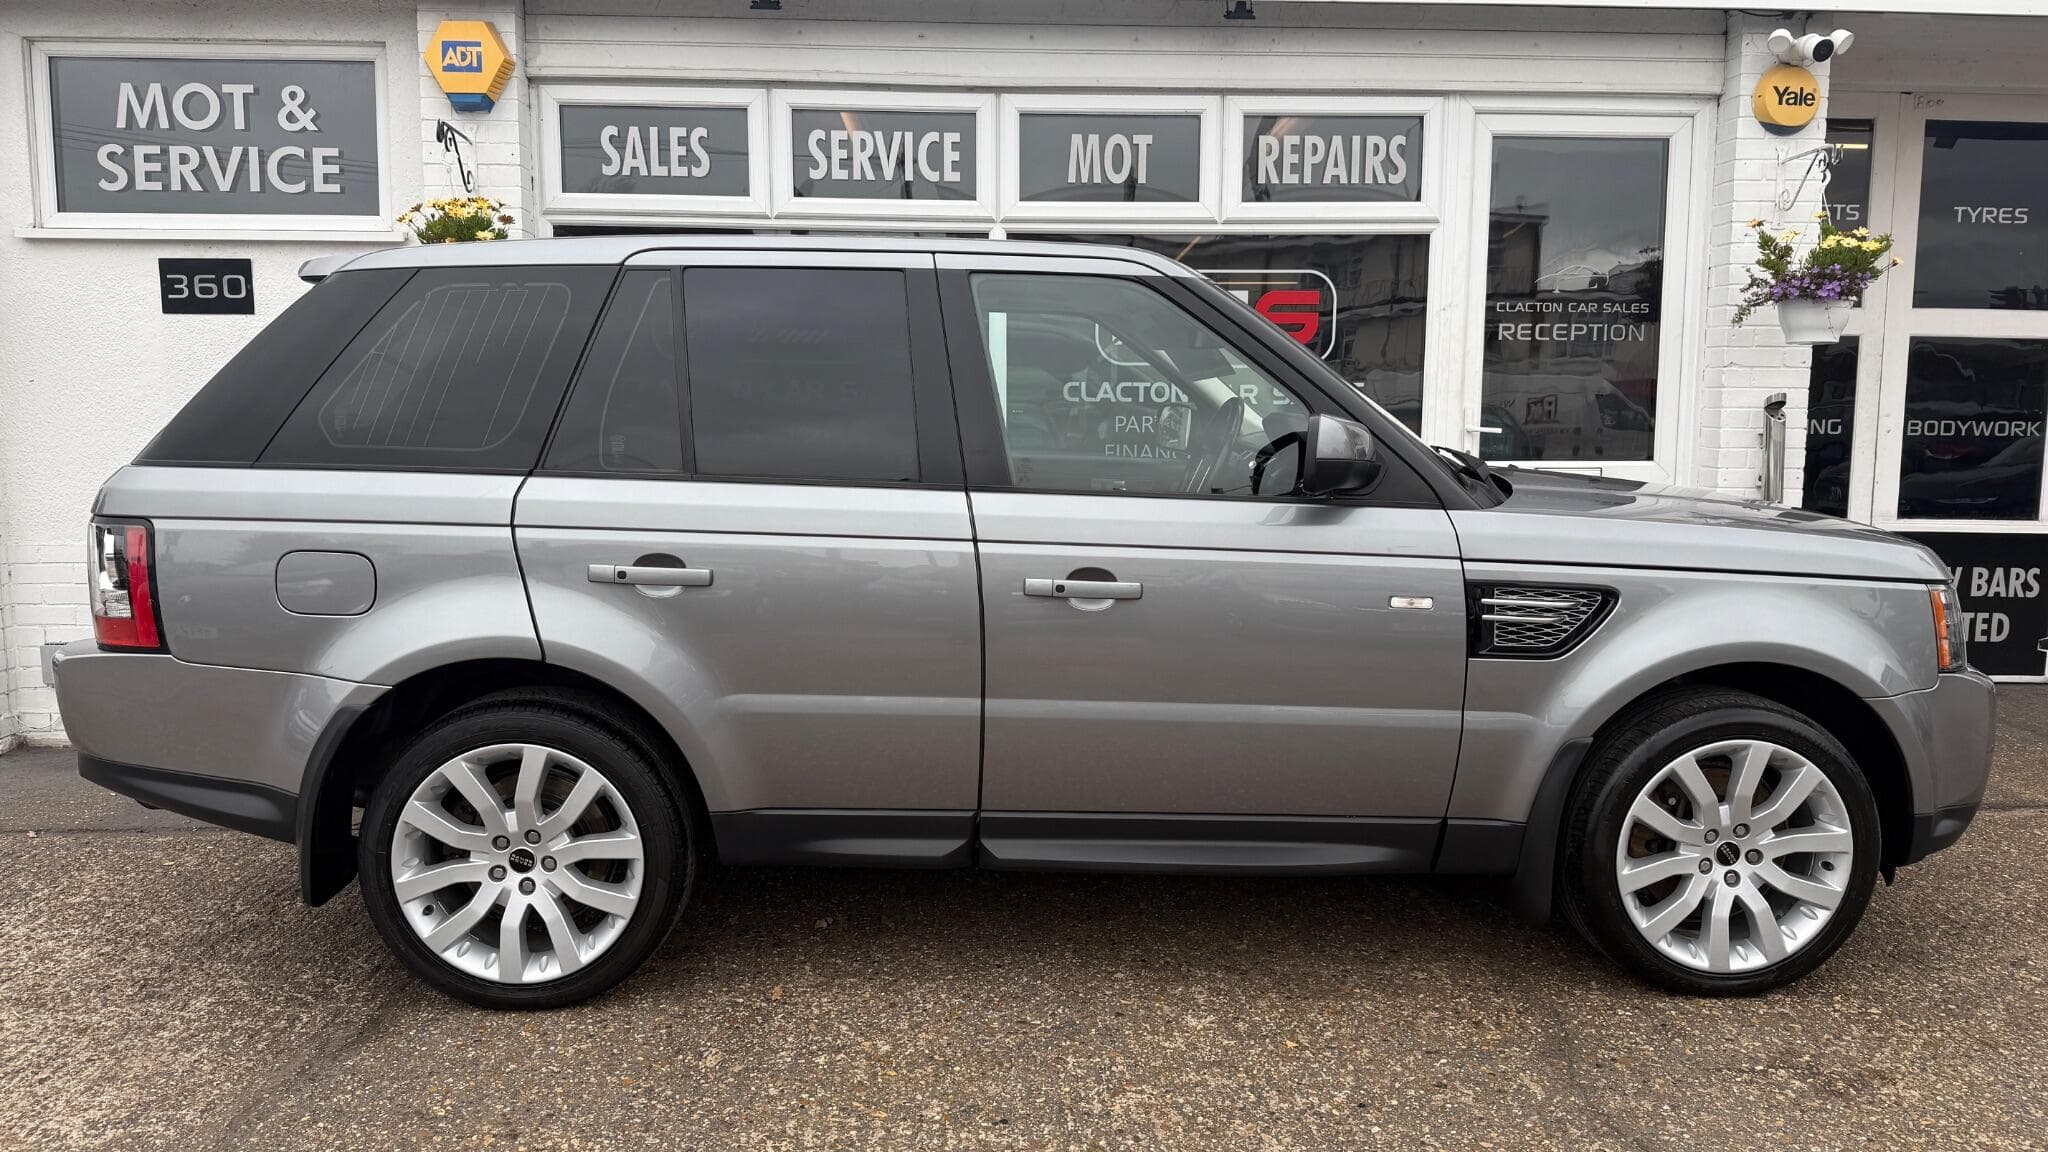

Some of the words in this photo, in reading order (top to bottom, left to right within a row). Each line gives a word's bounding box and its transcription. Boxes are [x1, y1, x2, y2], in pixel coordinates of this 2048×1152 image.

[442, 46, 482, 67] ADT
[116, 82, 254, 131] MOT
[277, 84, 318, 132] &
[1773, 86, 1815, 107] Yale
[601, 125, 711, 178] SALES
[808, 129, 961, 182] SERVICE
[1067, 133, 1153, 184] MOT
[1257, 135, 1407, 185] REPAIRS
[97, 143, 343, 194] SERVICE
[1954, 206, 2029, 223] TYRES
[167, 274, 247, 299] 360
[1496, 302, 1563, 313] CLACTON
[1568, 302, 1598, 313] CAR
[1603, 303, 1650, 313] SALES
[1498, 323, 1645, 342] RECEPTION
[1063, 381, 1189, 403] CLACTON
[1115, 415, 1158, 433] PAR
[1907, 420, 2042, 437] BODYWORK
[1970, 567, 2041, 598] BARS
